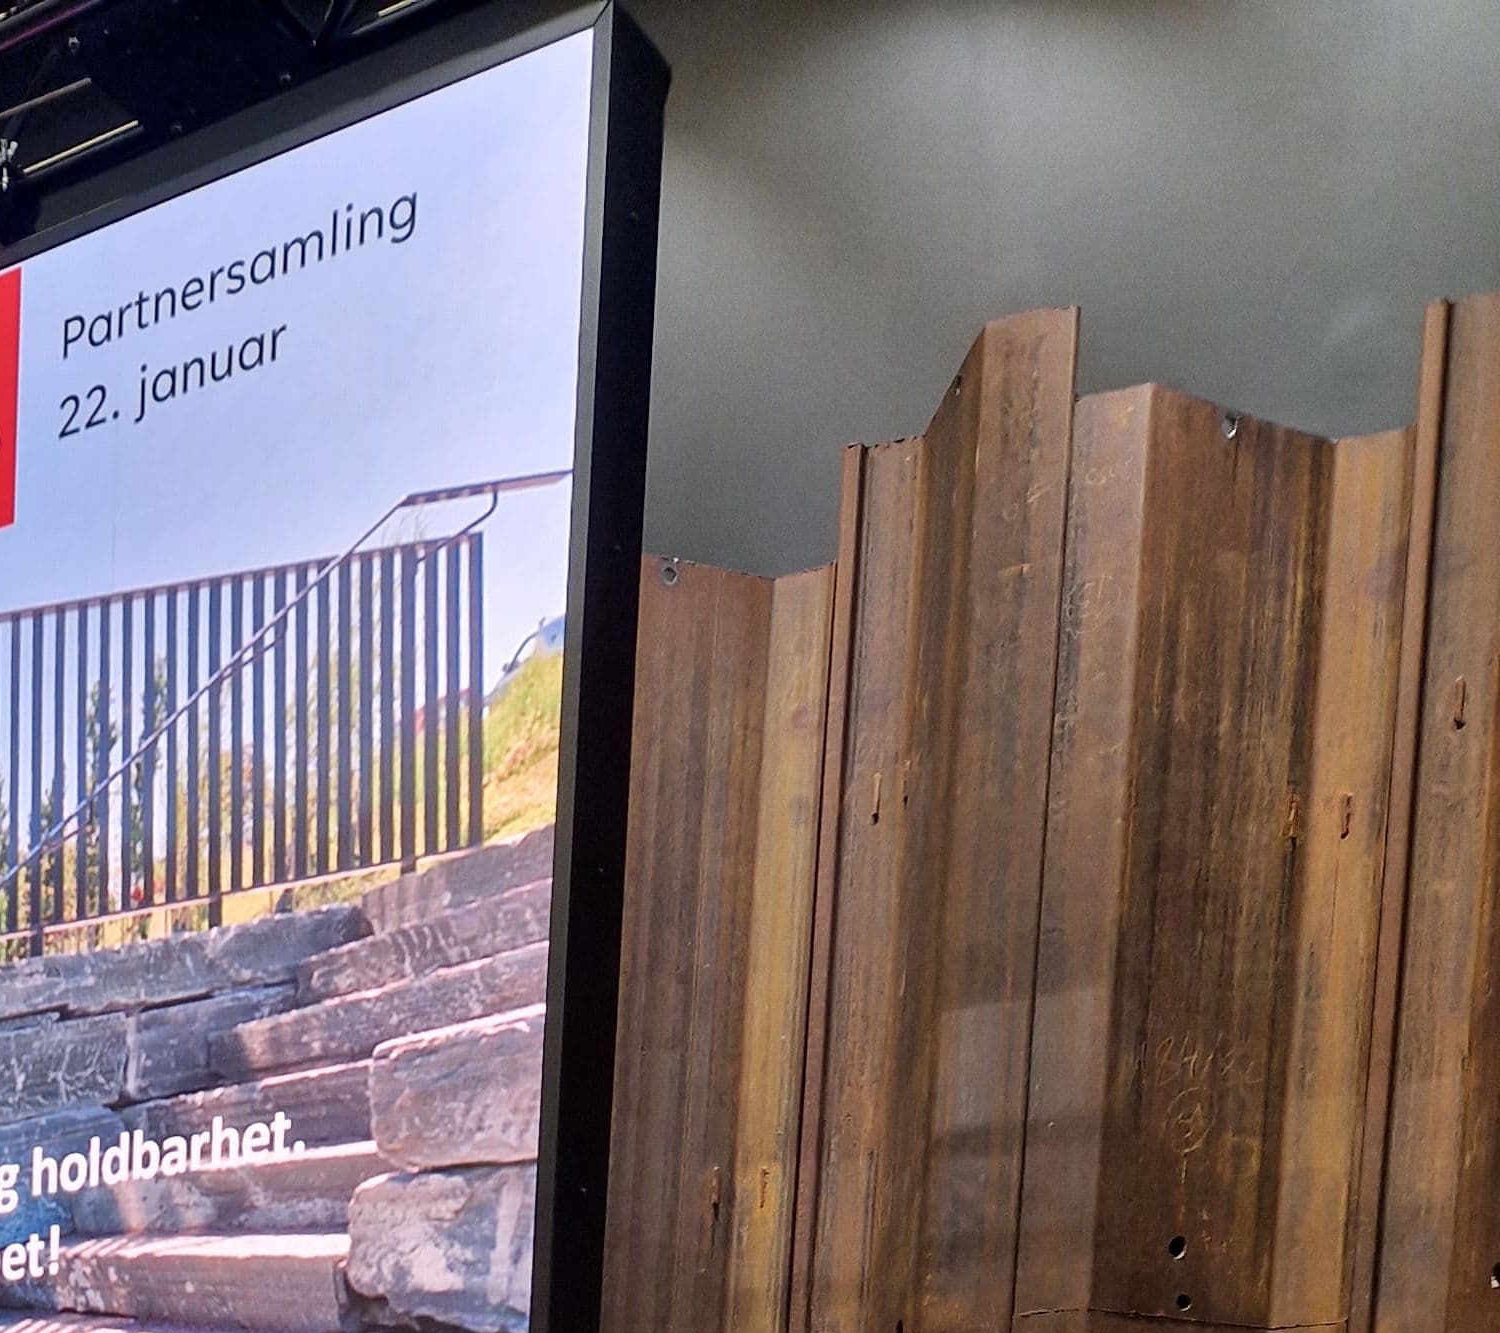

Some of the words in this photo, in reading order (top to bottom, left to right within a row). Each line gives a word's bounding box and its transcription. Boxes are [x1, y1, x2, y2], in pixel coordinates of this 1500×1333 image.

[61, 191, 419, 360] Partnersamling
[57, 384, 120, 440] 22.
[133, 323, 288, 424] januar
[31, 1110, 306, 1197] holdbarhet.
